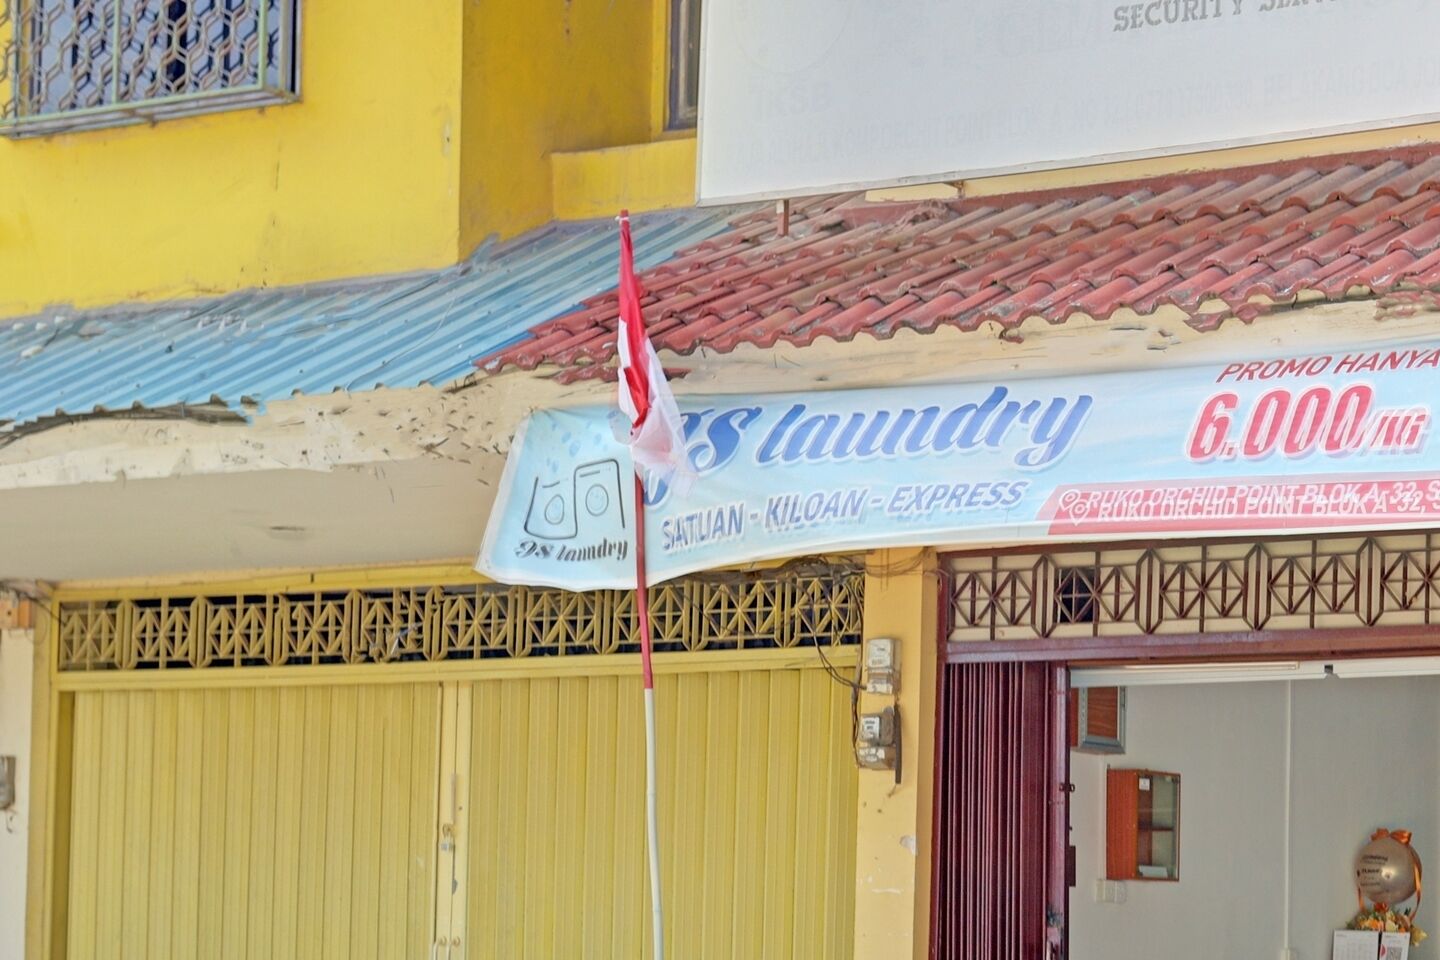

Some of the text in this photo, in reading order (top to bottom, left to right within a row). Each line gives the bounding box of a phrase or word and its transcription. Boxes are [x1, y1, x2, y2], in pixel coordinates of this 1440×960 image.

[1113, 0, 1243, 33] SECURITY
[1214, 355, 1333, 383] PROMO
[661, 503, 746, 551] SATUAN
[764, 488, 869, 530] KILOAN
[886, 480, 1031, 514] EXPRESS
